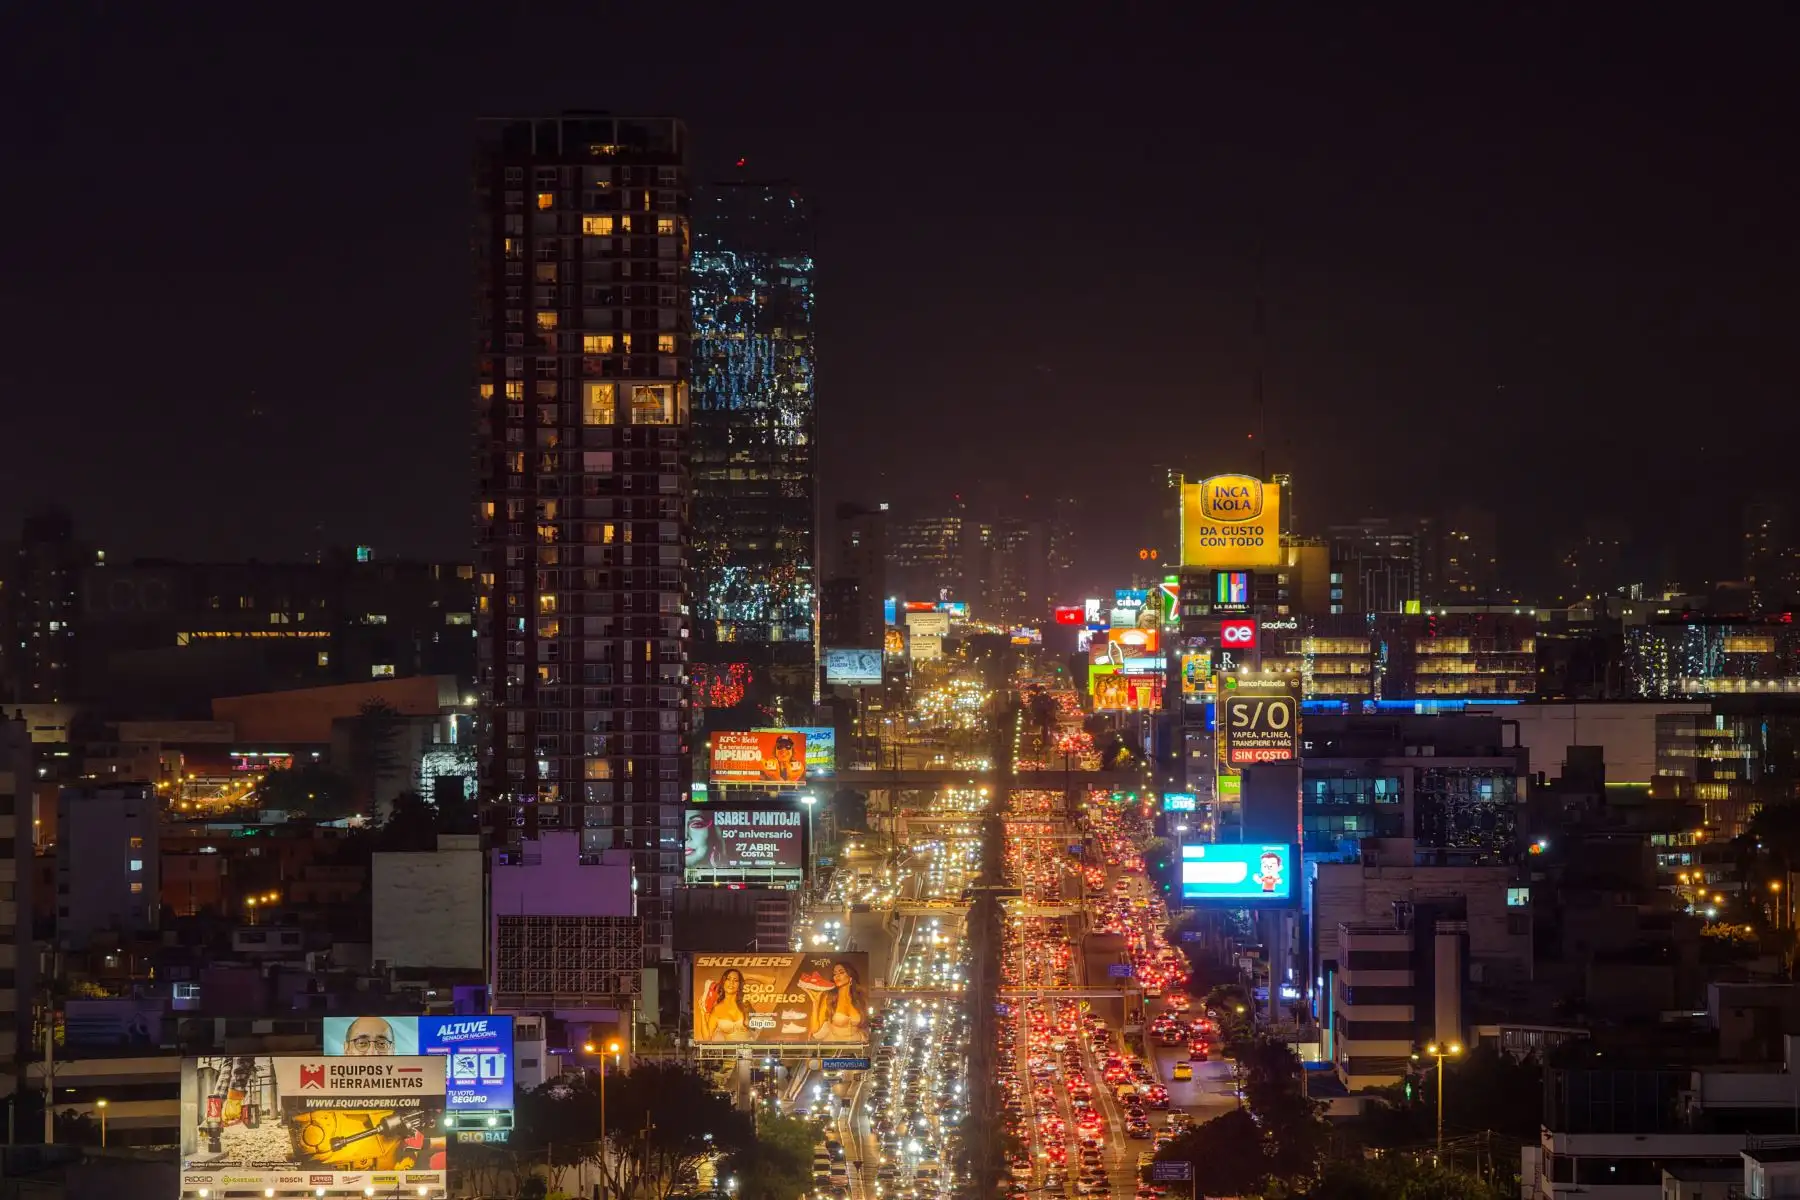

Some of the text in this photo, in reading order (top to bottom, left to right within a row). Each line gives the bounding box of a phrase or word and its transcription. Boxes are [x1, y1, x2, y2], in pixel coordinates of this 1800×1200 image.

[1215, 486, 1249, 498] INCA
[1212, 499, 1252, 512] KOLA
[1200, 526, 1264, 536] DA GUSTO
[1200, 538, 1264, 547] CON TODO
[1261, 621, 1298, 630] sodexo
[1224, 626, 1252, 642] oe
[1222, 652, 1233, 664] R
[714, 750, 762, 762] DIPEANDO
[1235, 751, 1289, 760] SIN COSTO
[714, 811, 800, 826] ISABEL PANTOJA
[738, 830, 793, 839] aniversario
[735, 843, 780, 852] 27 ABRIL
[696, 956, 794, 967] SKECHERS
[742, 984, 775, 993] SOLO
[437, 1020, 488, 1036] ALTUVE
[442, 1030, 498, 1042] SENADOR NACIONAL
[330, 1065, 393, 1077] EQUIPOS Y
[485, 1056, 496, 1077] 1
[330, 1078, 423, 1089] HERRAMIENTAS
[306, 1098, 420, 1108] WWW.EQUIPOSPERU.COM
[452, 1096, 488, 1104] SEGURO
[459, 1132, 508, 1142] GLOBAL
